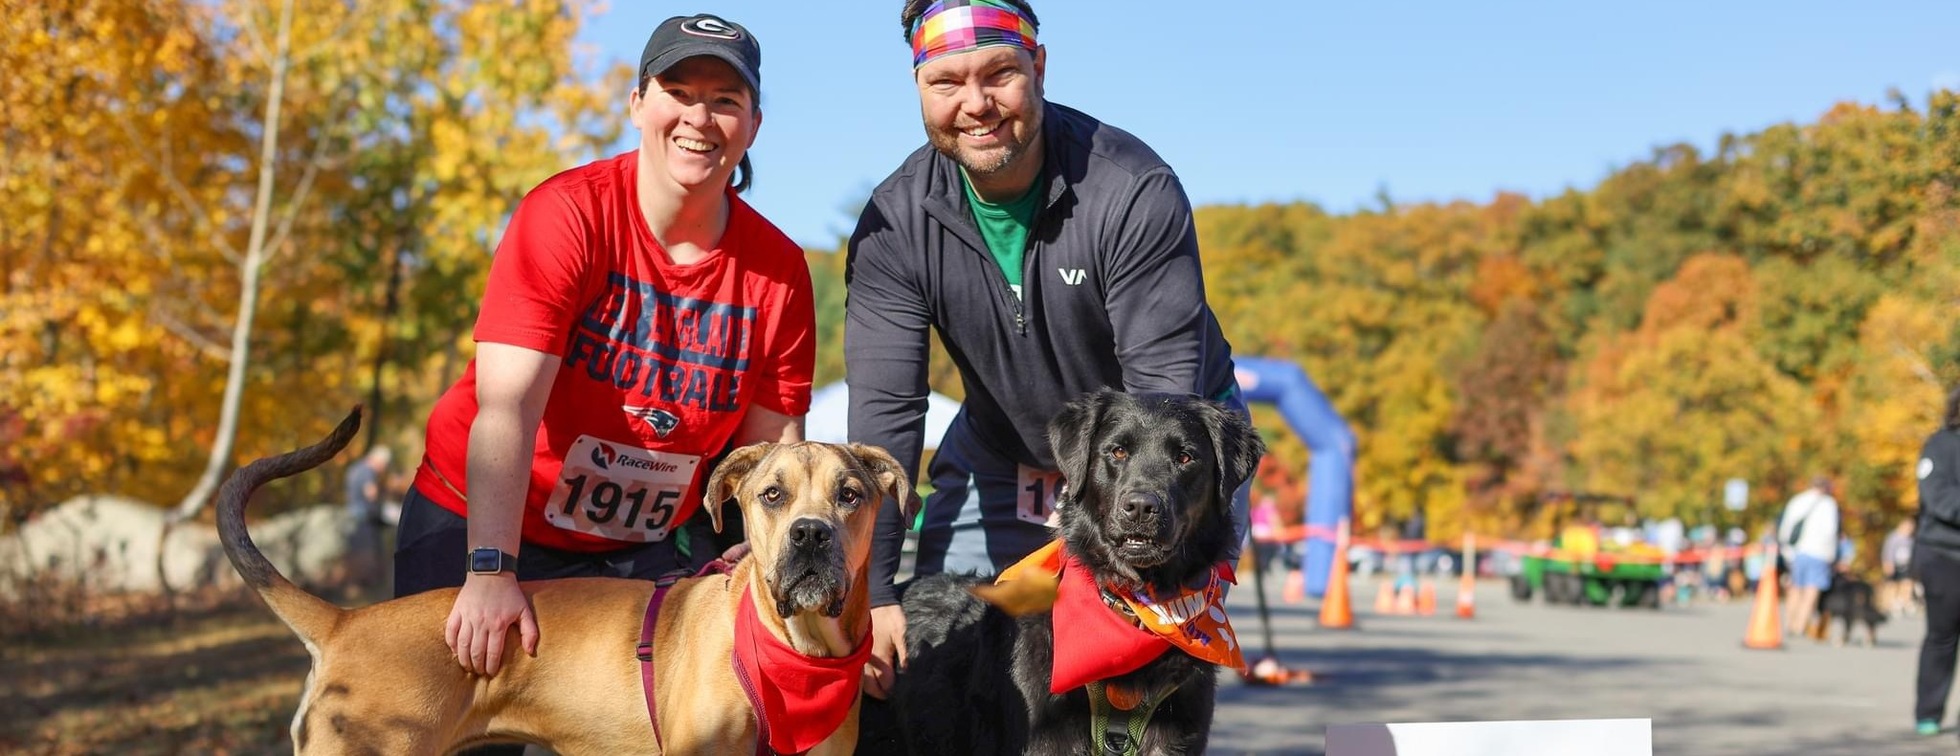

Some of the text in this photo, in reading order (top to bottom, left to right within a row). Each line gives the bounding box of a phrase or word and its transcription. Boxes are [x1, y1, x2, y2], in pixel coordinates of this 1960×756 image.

[565, 333, 743, 412] FOOTBALL
[616, 454, 678, 473] RaceWire
[562, 474, 682, 530] 1915
